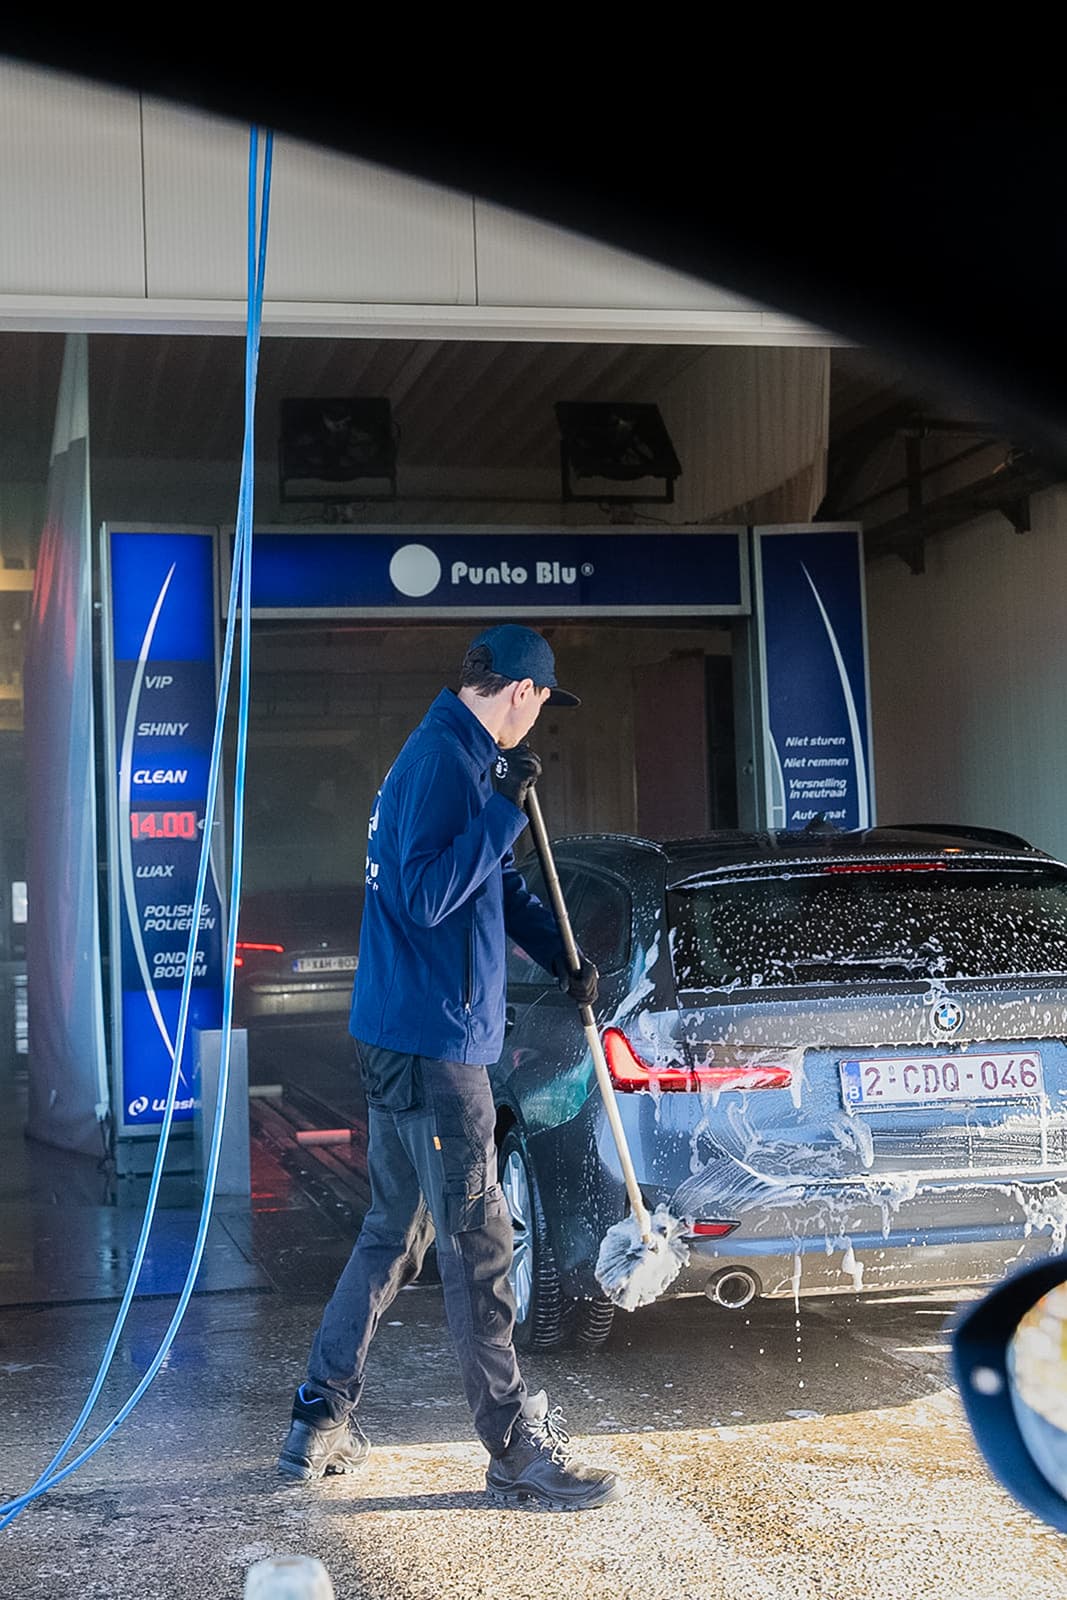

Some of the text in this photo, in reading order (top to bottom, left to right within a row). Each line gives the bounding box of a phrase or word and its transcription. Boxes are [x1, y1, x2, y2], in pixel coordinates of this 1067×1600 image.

[451, 561, 528, 585] Punto
[145, 675, 173, 689] VIP
[137, 722, 189, 737] SHINY
[785, 737, 846, 747] Niet sturen
[783, 758, 849, 768] Niet remmen
[133, 769, 187, 784] CLEAN
[789, 778, 847, 789] Versnelling
[789, 788, 847, 799] in neutraal
[130, 812, 195, 838] 14.00
[135, 864, 174, 878] WAX
[153, 951, 205, 965] ONDR
[153, 965, 208, 979] BODM
